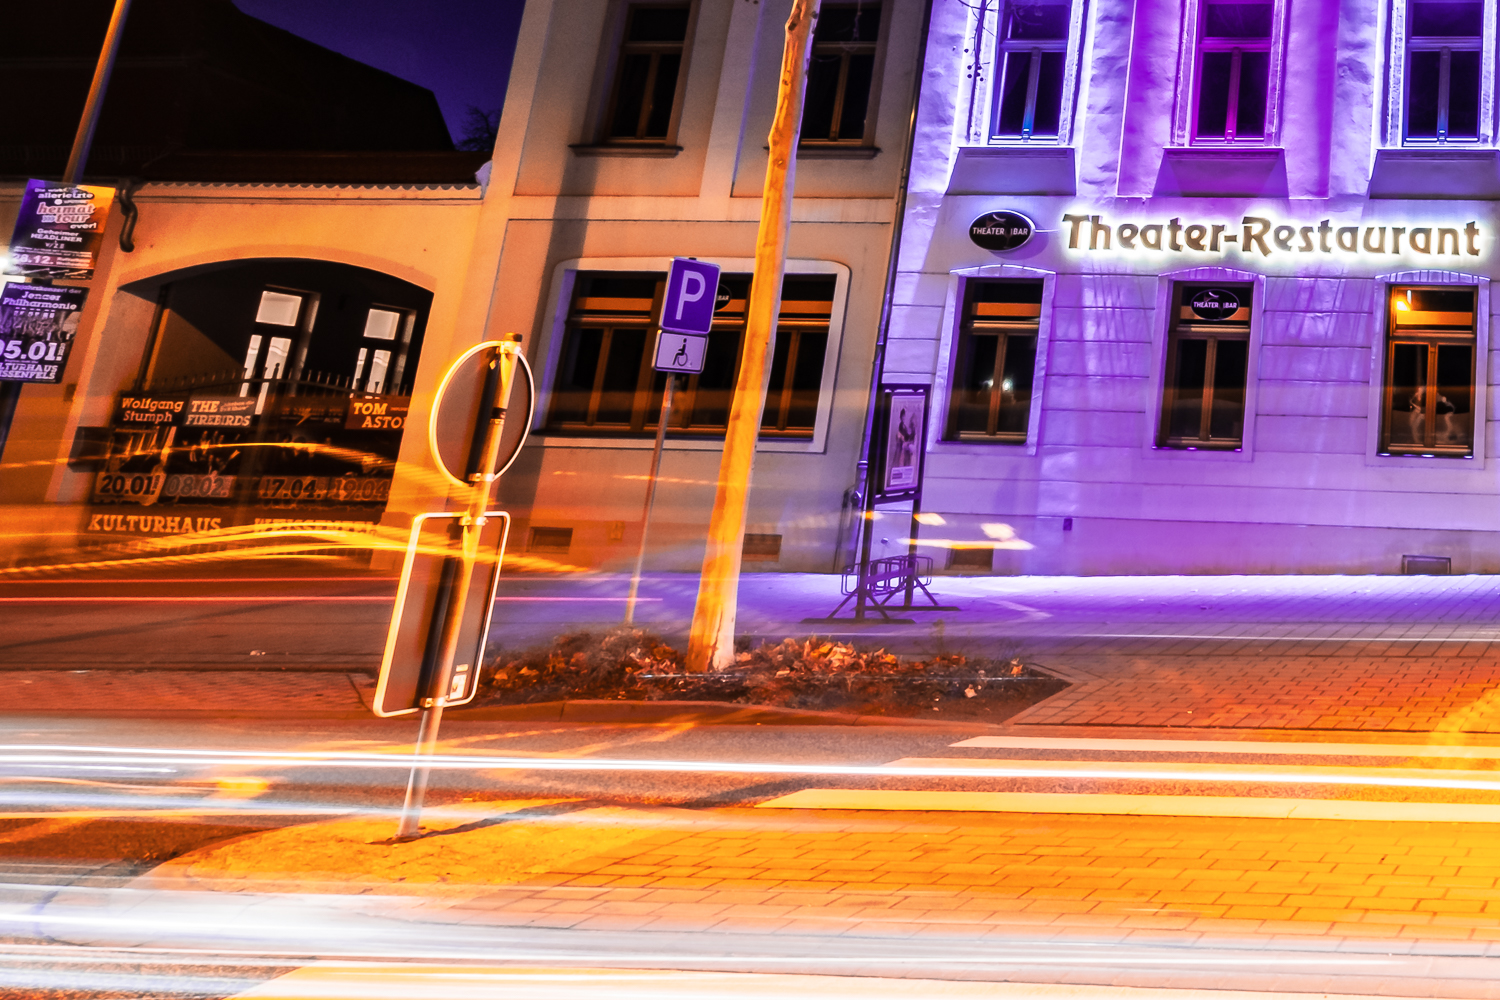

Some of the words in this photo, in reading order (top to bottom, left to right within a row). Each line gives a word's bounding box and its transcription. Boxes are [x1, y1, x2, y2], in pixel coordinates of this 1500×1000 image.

[36, 202, 96, 214] heimat
[55, 214, 91, 223] tour
[37, 228, 79, 236] Geheimer
[972, 226, 1005, 236] THEATER
[1013, 228, 1028, 236] BAR
[1062, 213, 1481, 257] Theater-Restaurant
[30, 233, 83, 242] HEADLINER
[675, 270, 706, 320] P
[3, 298, 77, 310] Philharmonie
[1193, 301, 1220, 309] THEATER
[1224, 302, 1238, 310] BAR
[122, 398, 184, 412] Wolfgang
[191, 400, 220, 412] THE
[354, 402, 388, 415] TOM
[123, 410, 172, 424] Stumph
[186, 414, 251, 426] FIREBIRDS
[362, 416, 405, 429] ASTO
[88, 514, 222, 534] KULTURHAUS
